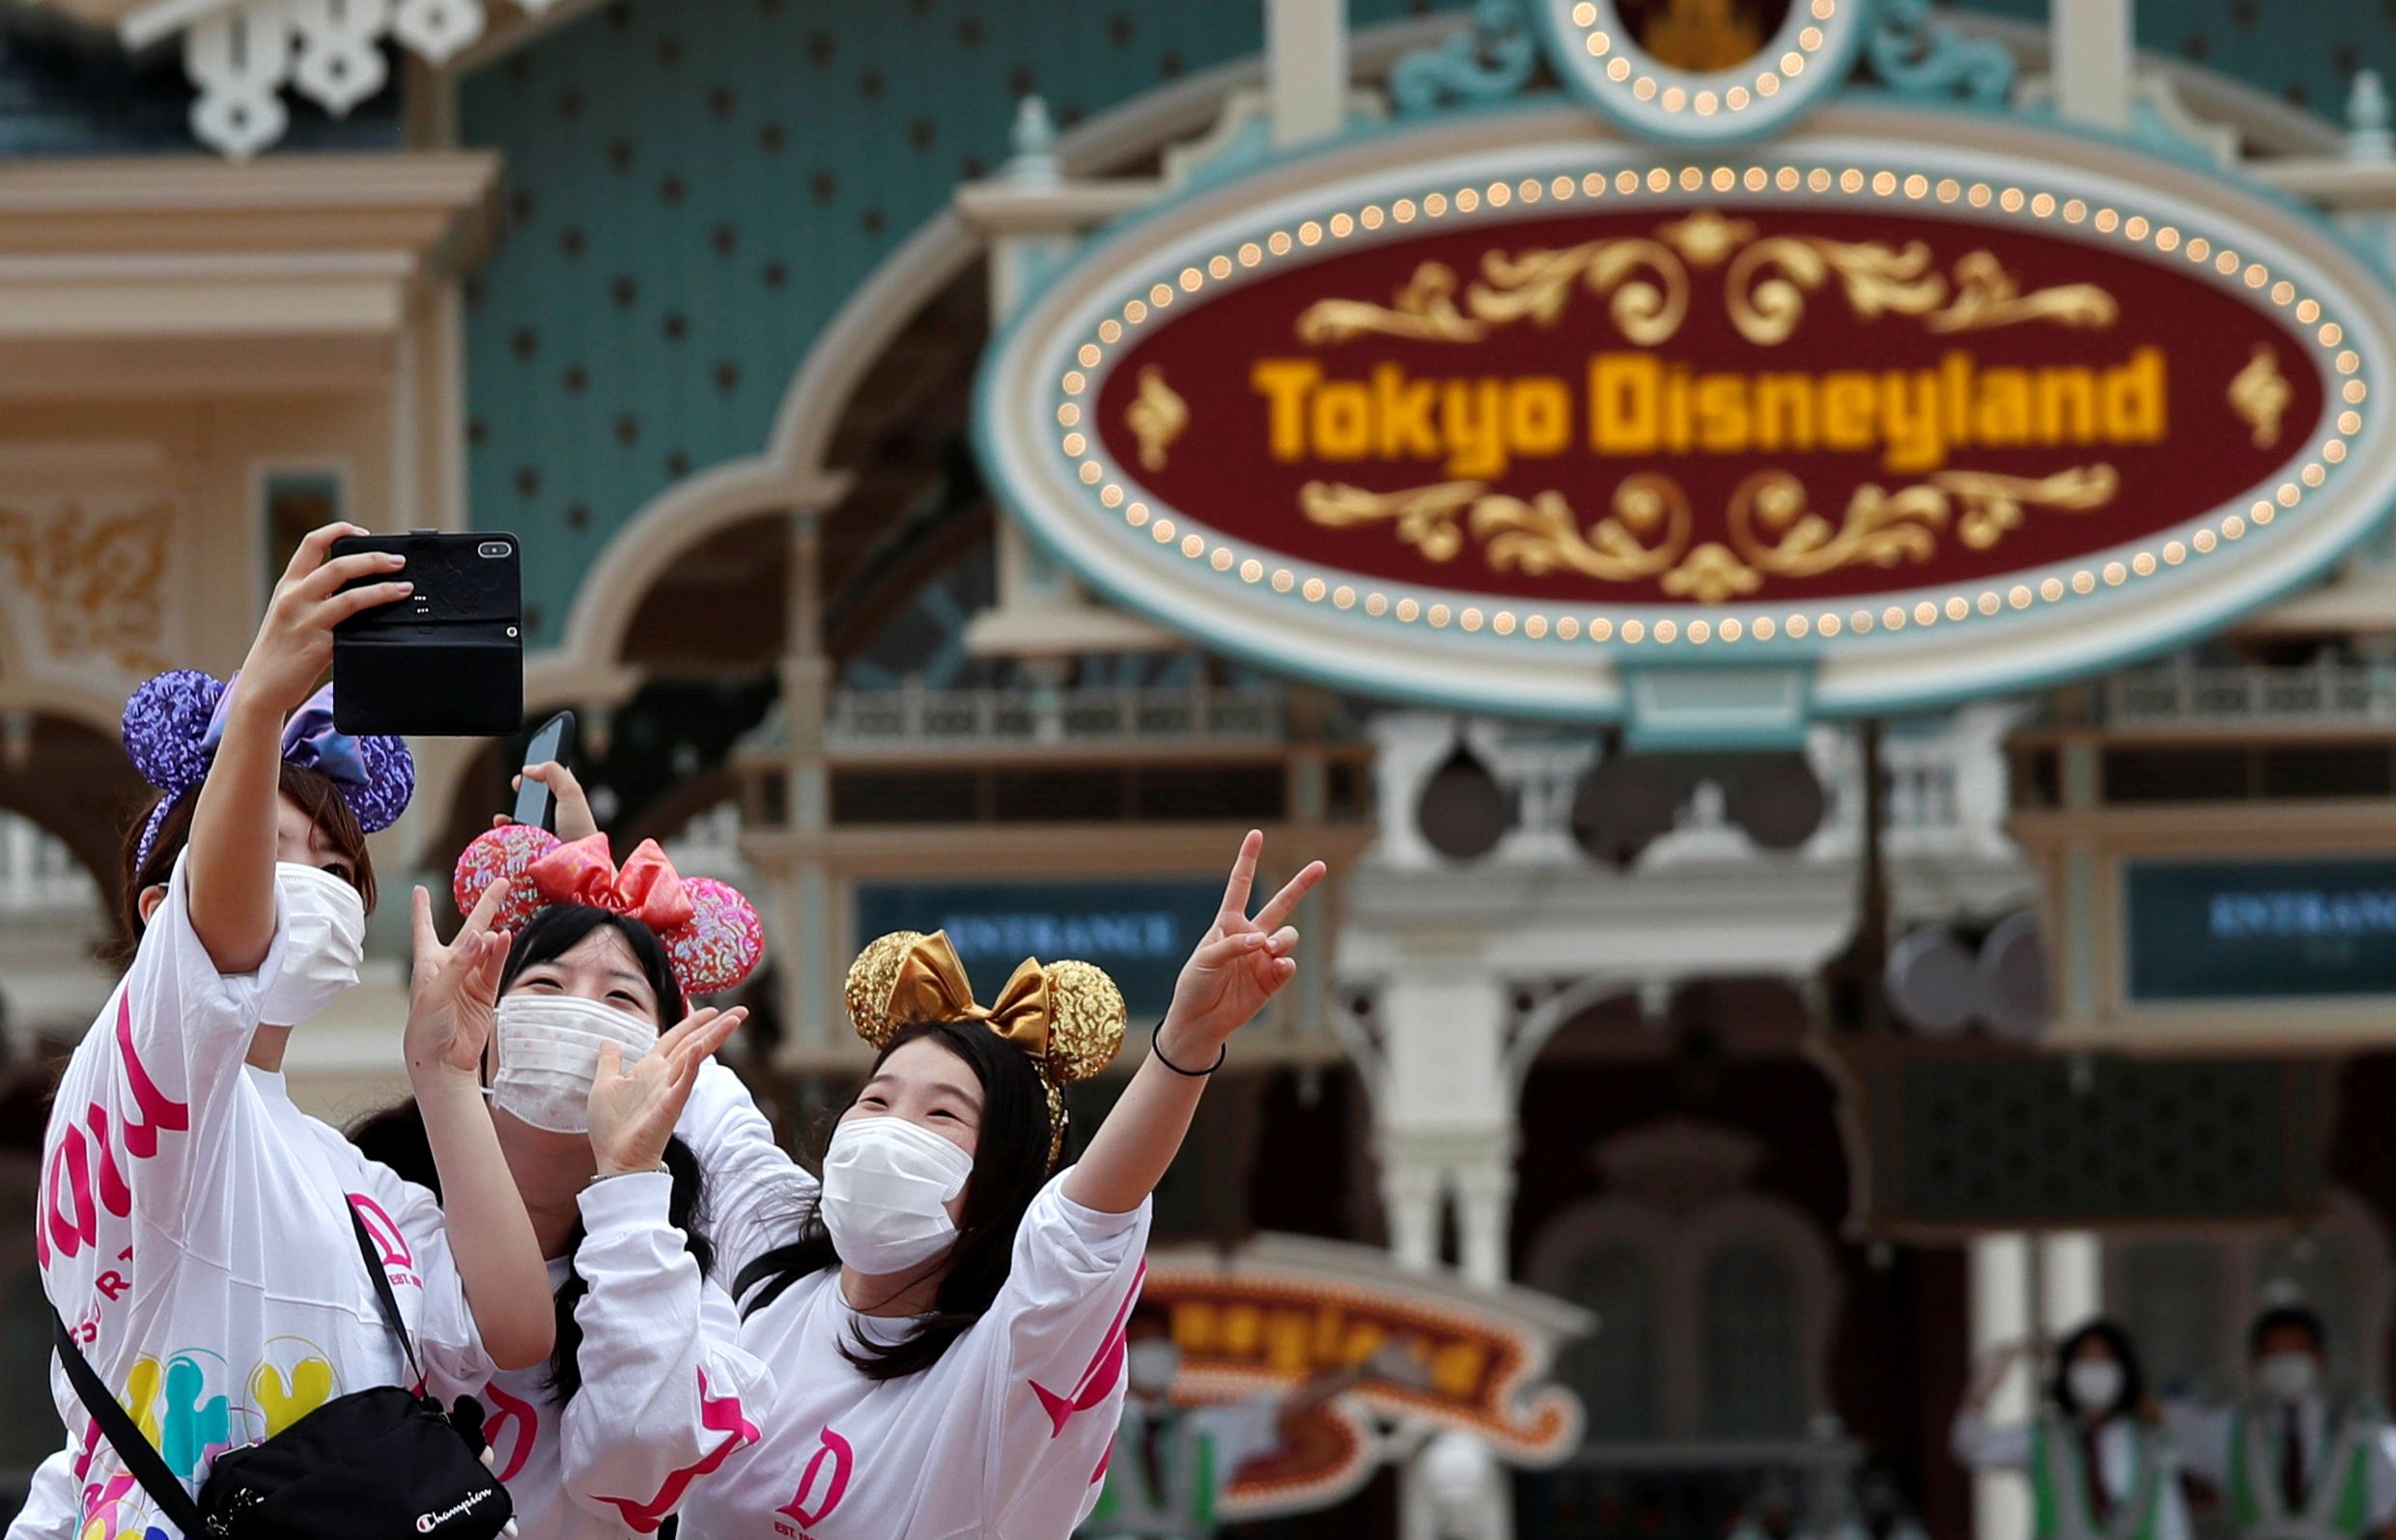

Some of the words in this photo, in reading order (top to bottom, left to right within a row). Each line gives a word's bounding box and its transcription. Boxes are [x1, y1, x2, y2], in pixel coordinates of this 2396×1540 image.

[1253, 359, 1571, 478] Tokyo
[1588, 350, 2166, 471] Disneyland
[416, 1489, 492, 1533] Champion
[775, 1425, 853, 1529] D
